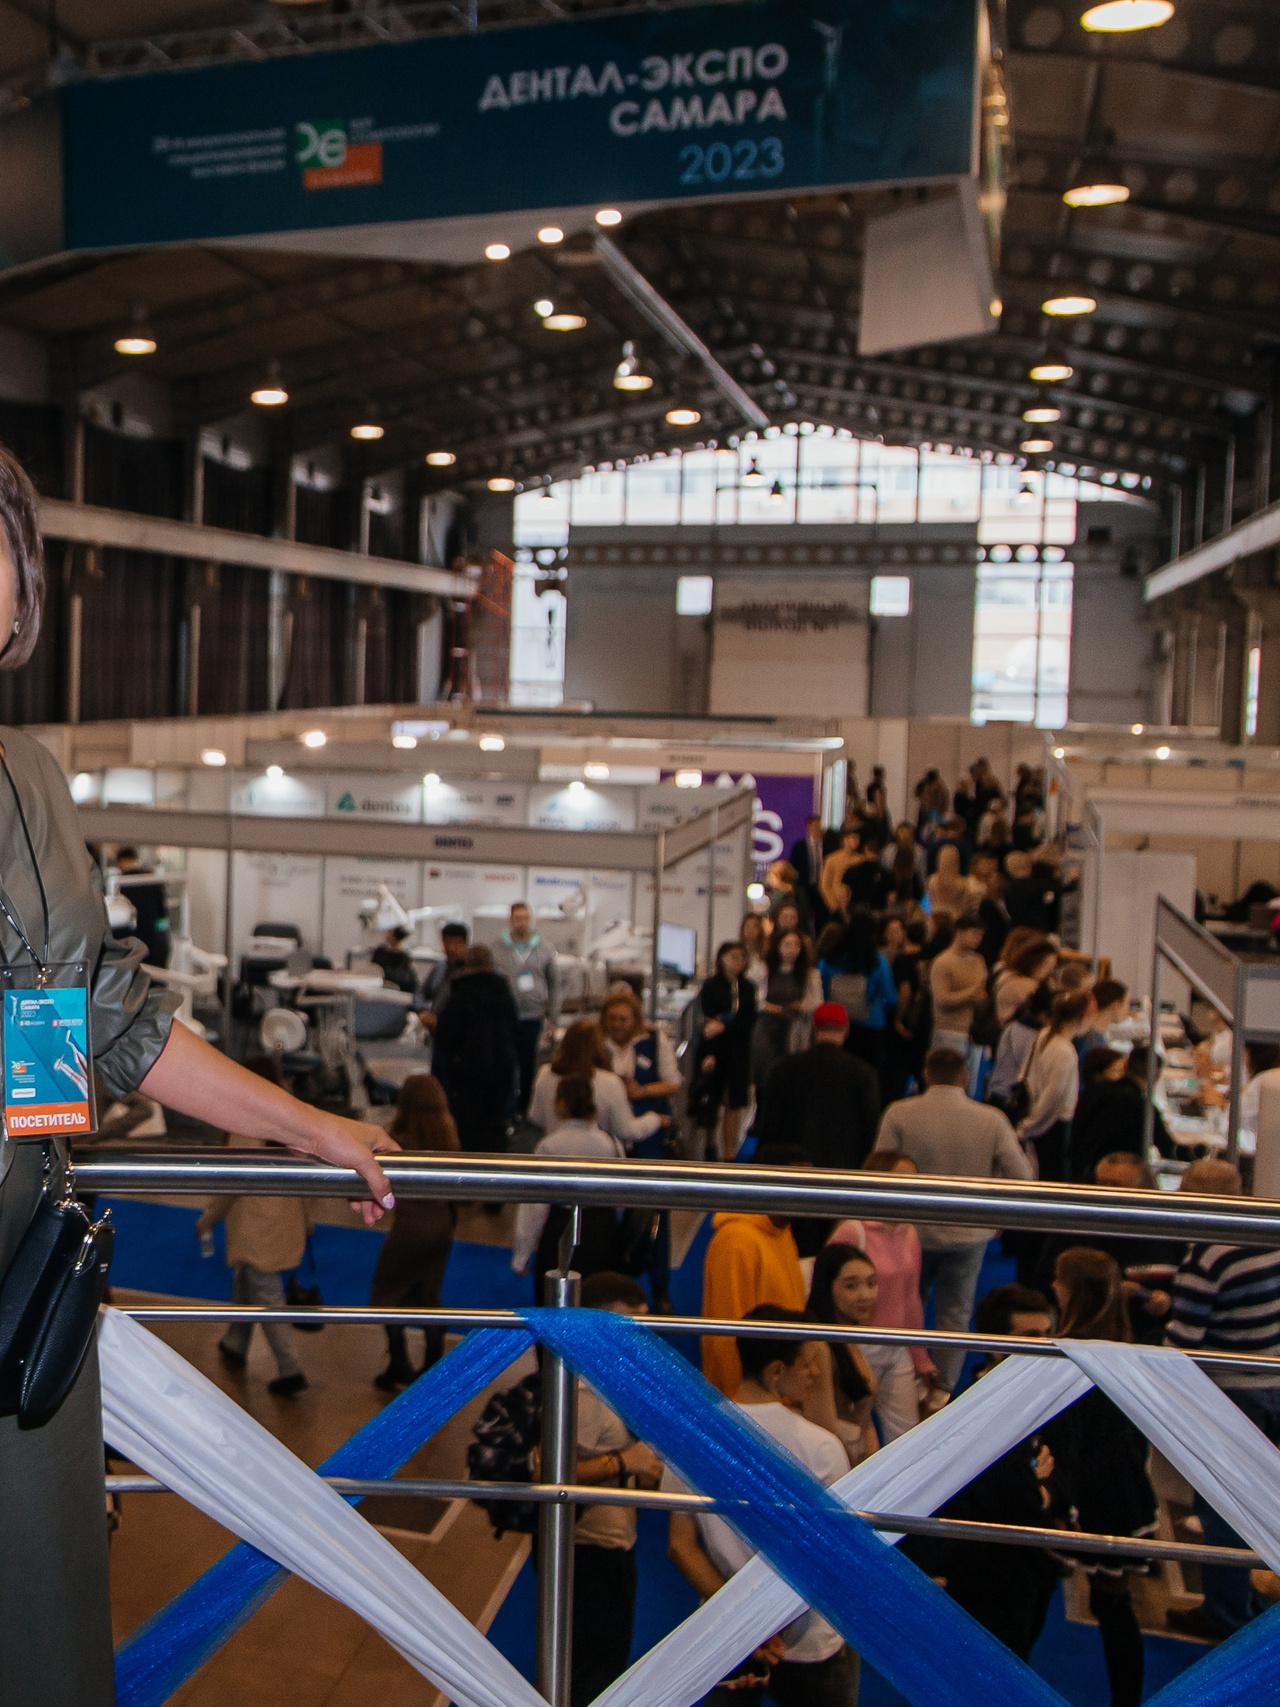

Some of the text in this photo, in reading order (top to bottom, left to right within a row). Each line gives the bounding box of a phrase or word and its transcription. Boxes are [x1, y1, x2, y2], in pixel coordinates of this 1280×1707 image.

[478, 42, 789, 111] ДЕНТАЛ-ЭКСПО
[610, 86, 787, 136] САМАРА
[679, 137, 786, 185] 2023
[10, 1112, 86, 1129] ПОСЕТИТЕЛЬ
